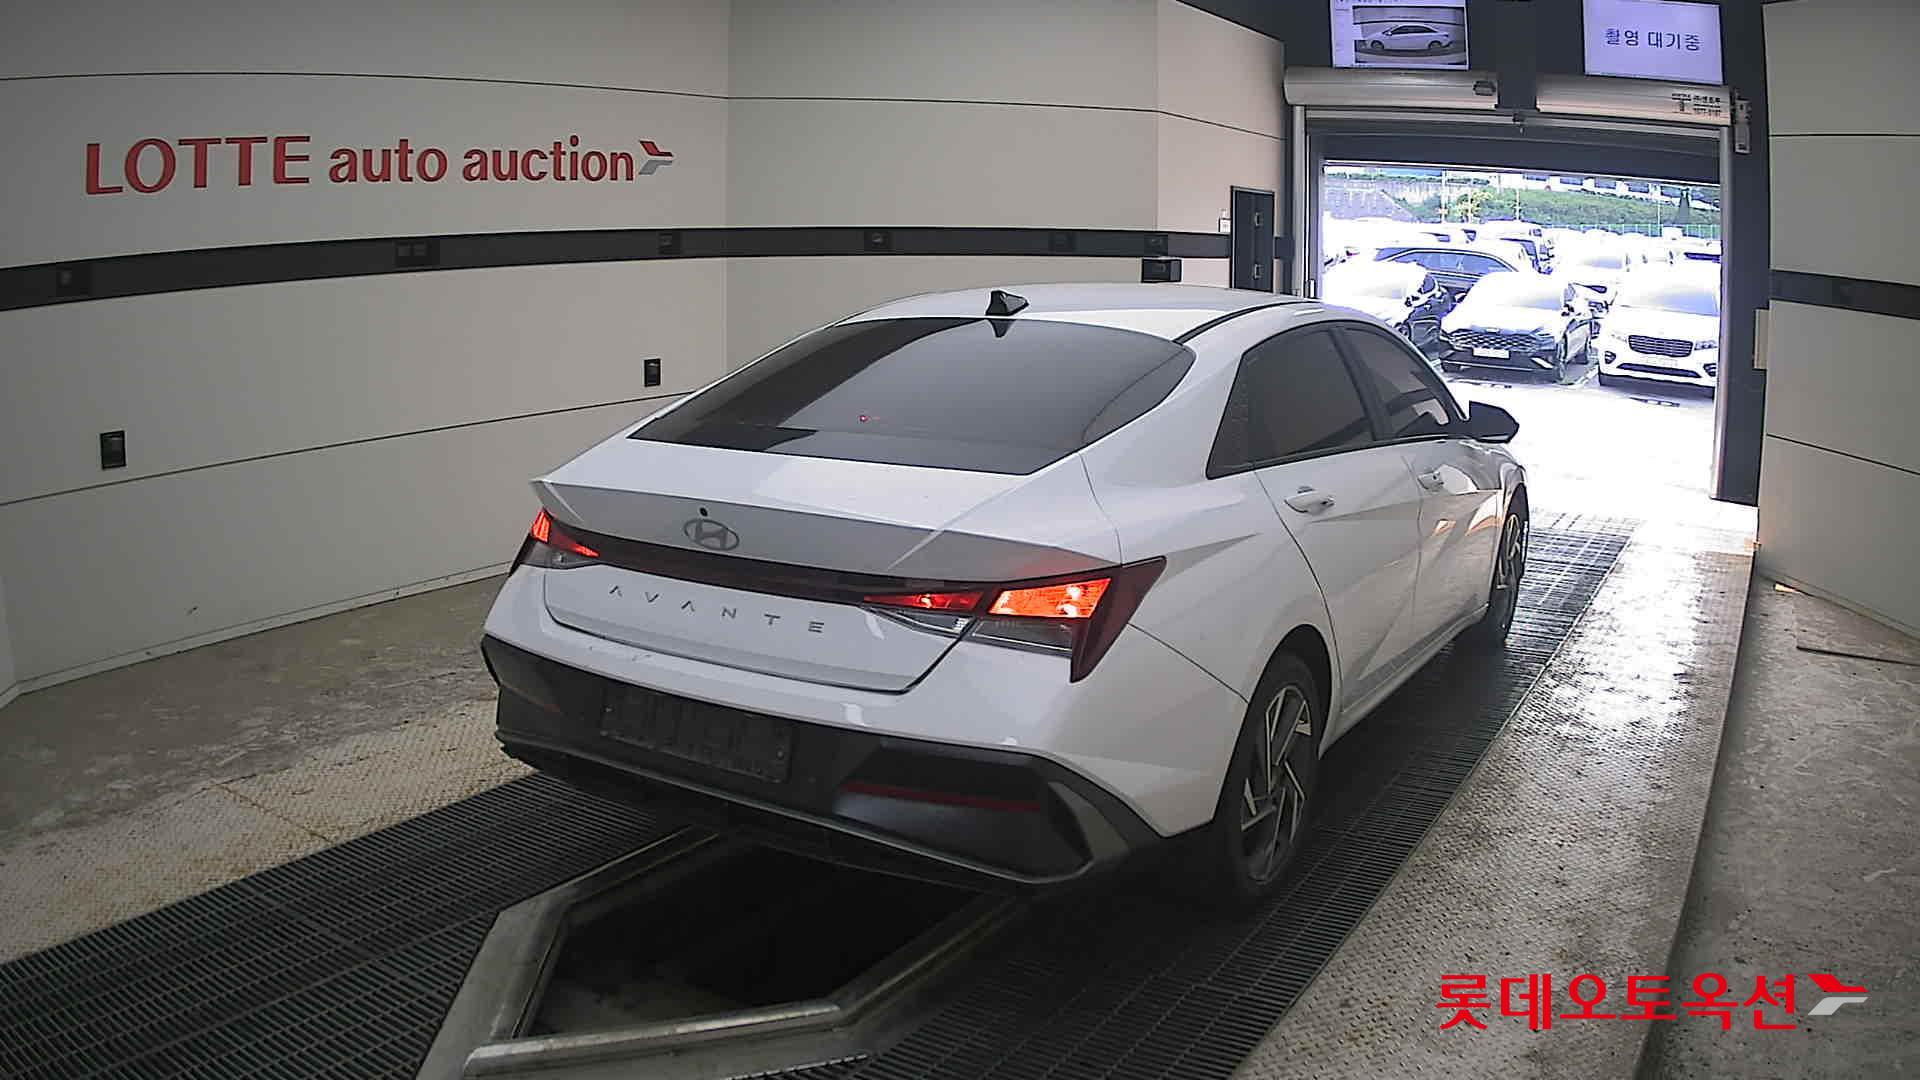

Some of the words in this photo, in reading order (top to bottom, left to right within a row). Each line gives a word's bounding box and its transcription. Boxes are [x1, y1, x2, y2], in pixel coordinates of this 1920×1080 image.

[1646, 30, 1702, 52] 대기중
[84, 135, 311, 195] LOTTE
[328, 138, 449, 183] auto
[462, 135, 636, 182] auction
[608, 584, 826, 634] AVANTE
